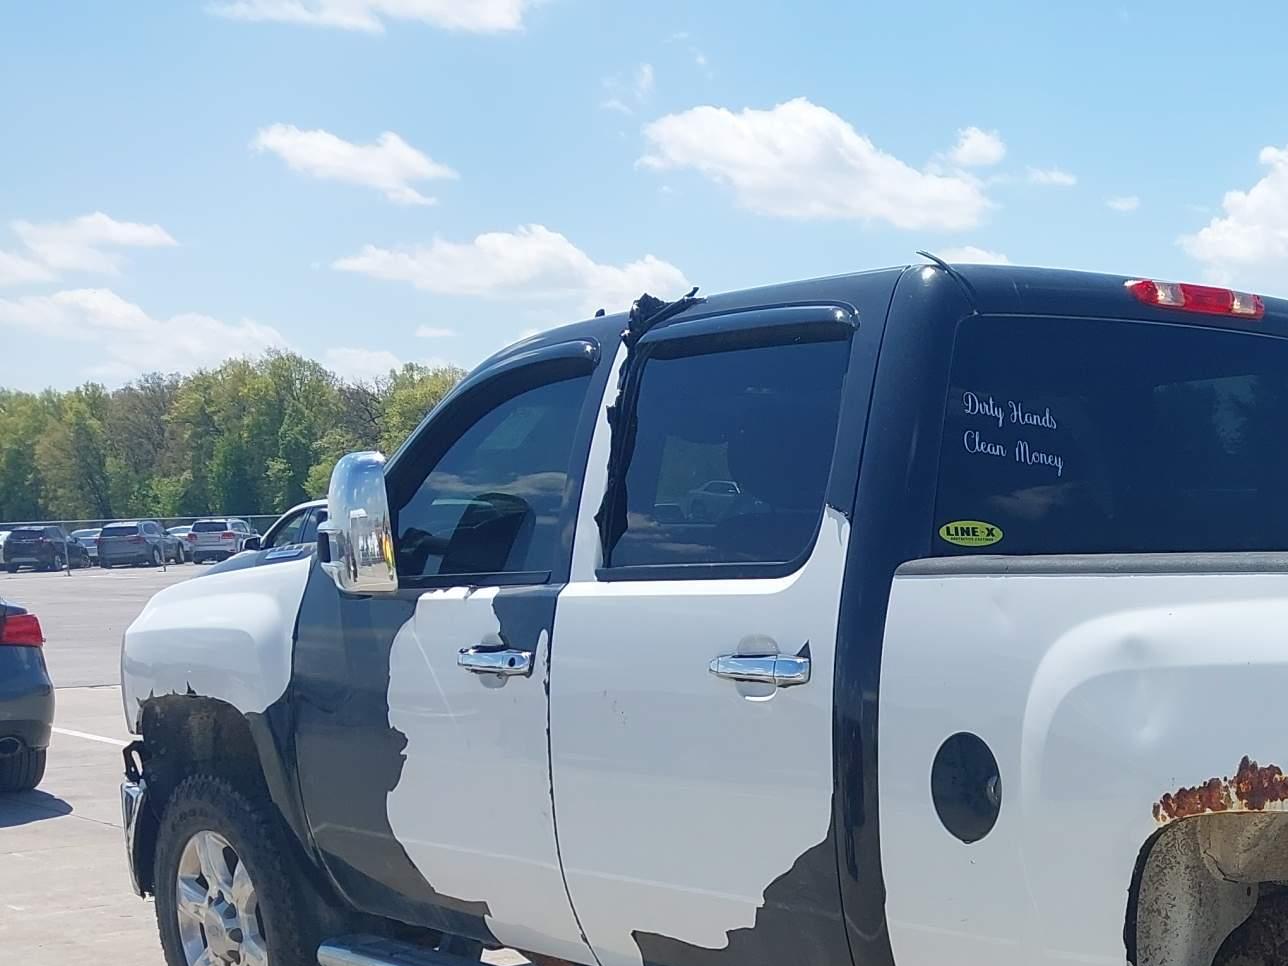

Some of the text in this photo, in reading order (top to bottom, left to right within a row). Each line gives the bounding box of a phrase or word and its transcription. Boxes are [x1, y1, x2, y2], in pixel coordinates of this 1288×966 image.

[963, 391, 1057, 429] Dirty Hands
[963, 430, 1064, 477] Clean Money
[945, 526, 996, 537] LINE-X
